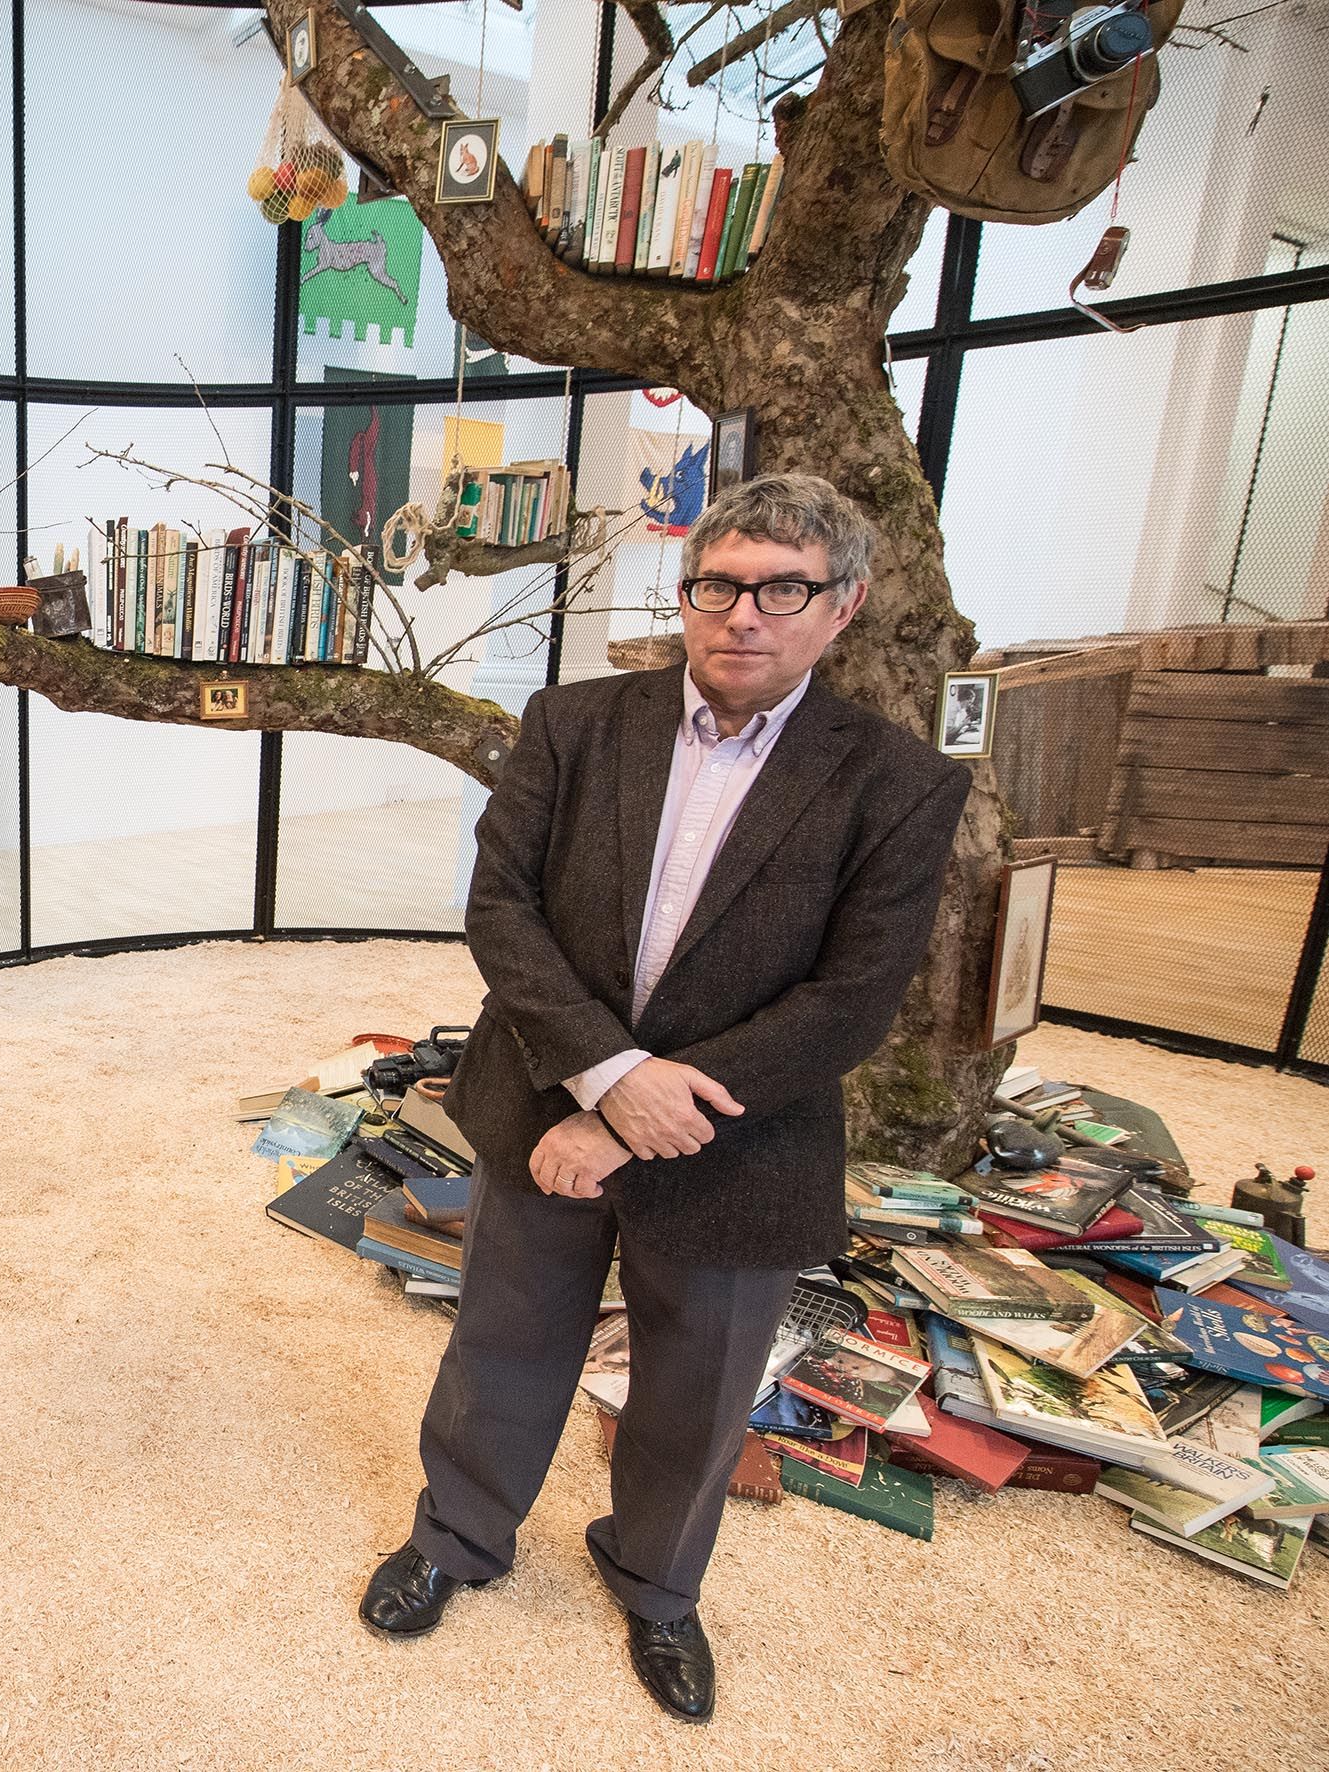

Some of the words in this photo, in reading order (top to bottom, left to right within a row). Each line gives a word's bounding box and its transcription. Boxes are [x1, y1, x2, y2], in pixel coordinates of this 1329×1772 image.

[613, 148, 624, 171] SCOTT
[607, 182, 621, 222] ANTARCTIC
[241, 535, 249, 557] Contry
[212, 563, 219, 572] OF
[313, 555, 325, 596] BRTISH
[364, 575, 371, 585] OF
[156, 572, 164, 608] ANIMALS
[186, 568, 195, 606] Magnificent
[210, 574, 218, 608] AMERICA
[223, 573, 234, 595] BIRDS
[185, 607, 193, 632] Wildlife
[221, 601, 231, 628] WORLD
[310, 599, 322, 630] BIRDS
[359, 619, 367, 642] BRDS
[329, 1186, 373, 1208] BRITIS
[344, 1180, 362, 1190] OF
[363, 1188, 382, 1201] TH
[981, 1190, 1051, 1213] wildlife
[327, 1198, 362, 1216] ISLES
[957, 1310, 1012, 1318] WOODLAND
[1201, 1308, 1231, 1342] Shells
[832, 1331, 922, 1372] DORMICE
[778, 1436, 798, 1448] Roar
[825, 1454, 849, 1468] Dove
[1173, 1443, 1251, 1480] WALKER'S
[1027, 1466, 1053, 1474] Noms
[1172, 1451, 1232, 1480] BRITAIN
